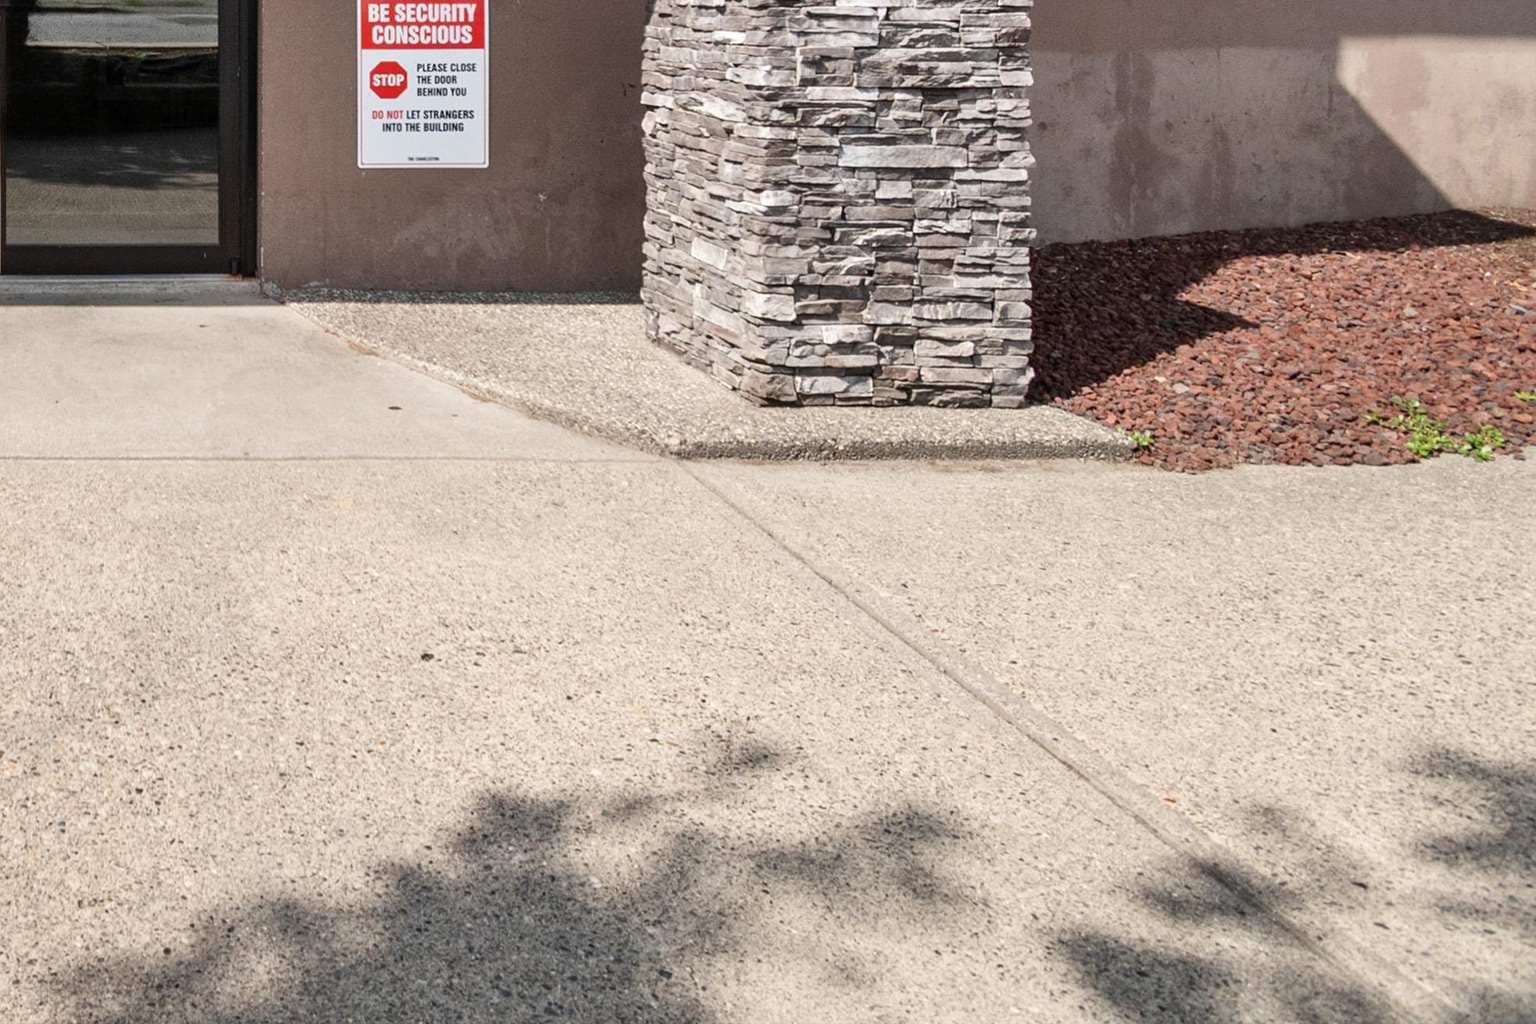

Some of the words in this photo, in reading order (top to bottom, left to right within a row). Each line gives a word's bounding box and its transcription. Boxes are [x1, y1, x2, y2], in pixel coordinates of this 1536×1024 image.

[368, 3, 390, 23] BE
[394, 3, 477, 23] SECURITY
[371, 25, 473, 45] CONSCIOUS
[416, 63, 448, 73] PLEASE
[450, 63, 477, 73] CLOSE
[372, 73, 405, 87] STOP
[417, 75, 432, 84] THE
[434, 75, 457, 84] DOOR
[417, 87, 448, 97] BEHIND
[450, 87, 467, 97] YOU
[372, 110, 384, 120] DO
[386, 110, 404, 120] NOT
[406, 110, 421, 120] LET
[423, 110, 475, 120] STRANGERS
[382, 122, 403, 132] INTO
[405, 122, 421, 132] THE
[423, 122, 464, 132] BUILDING
